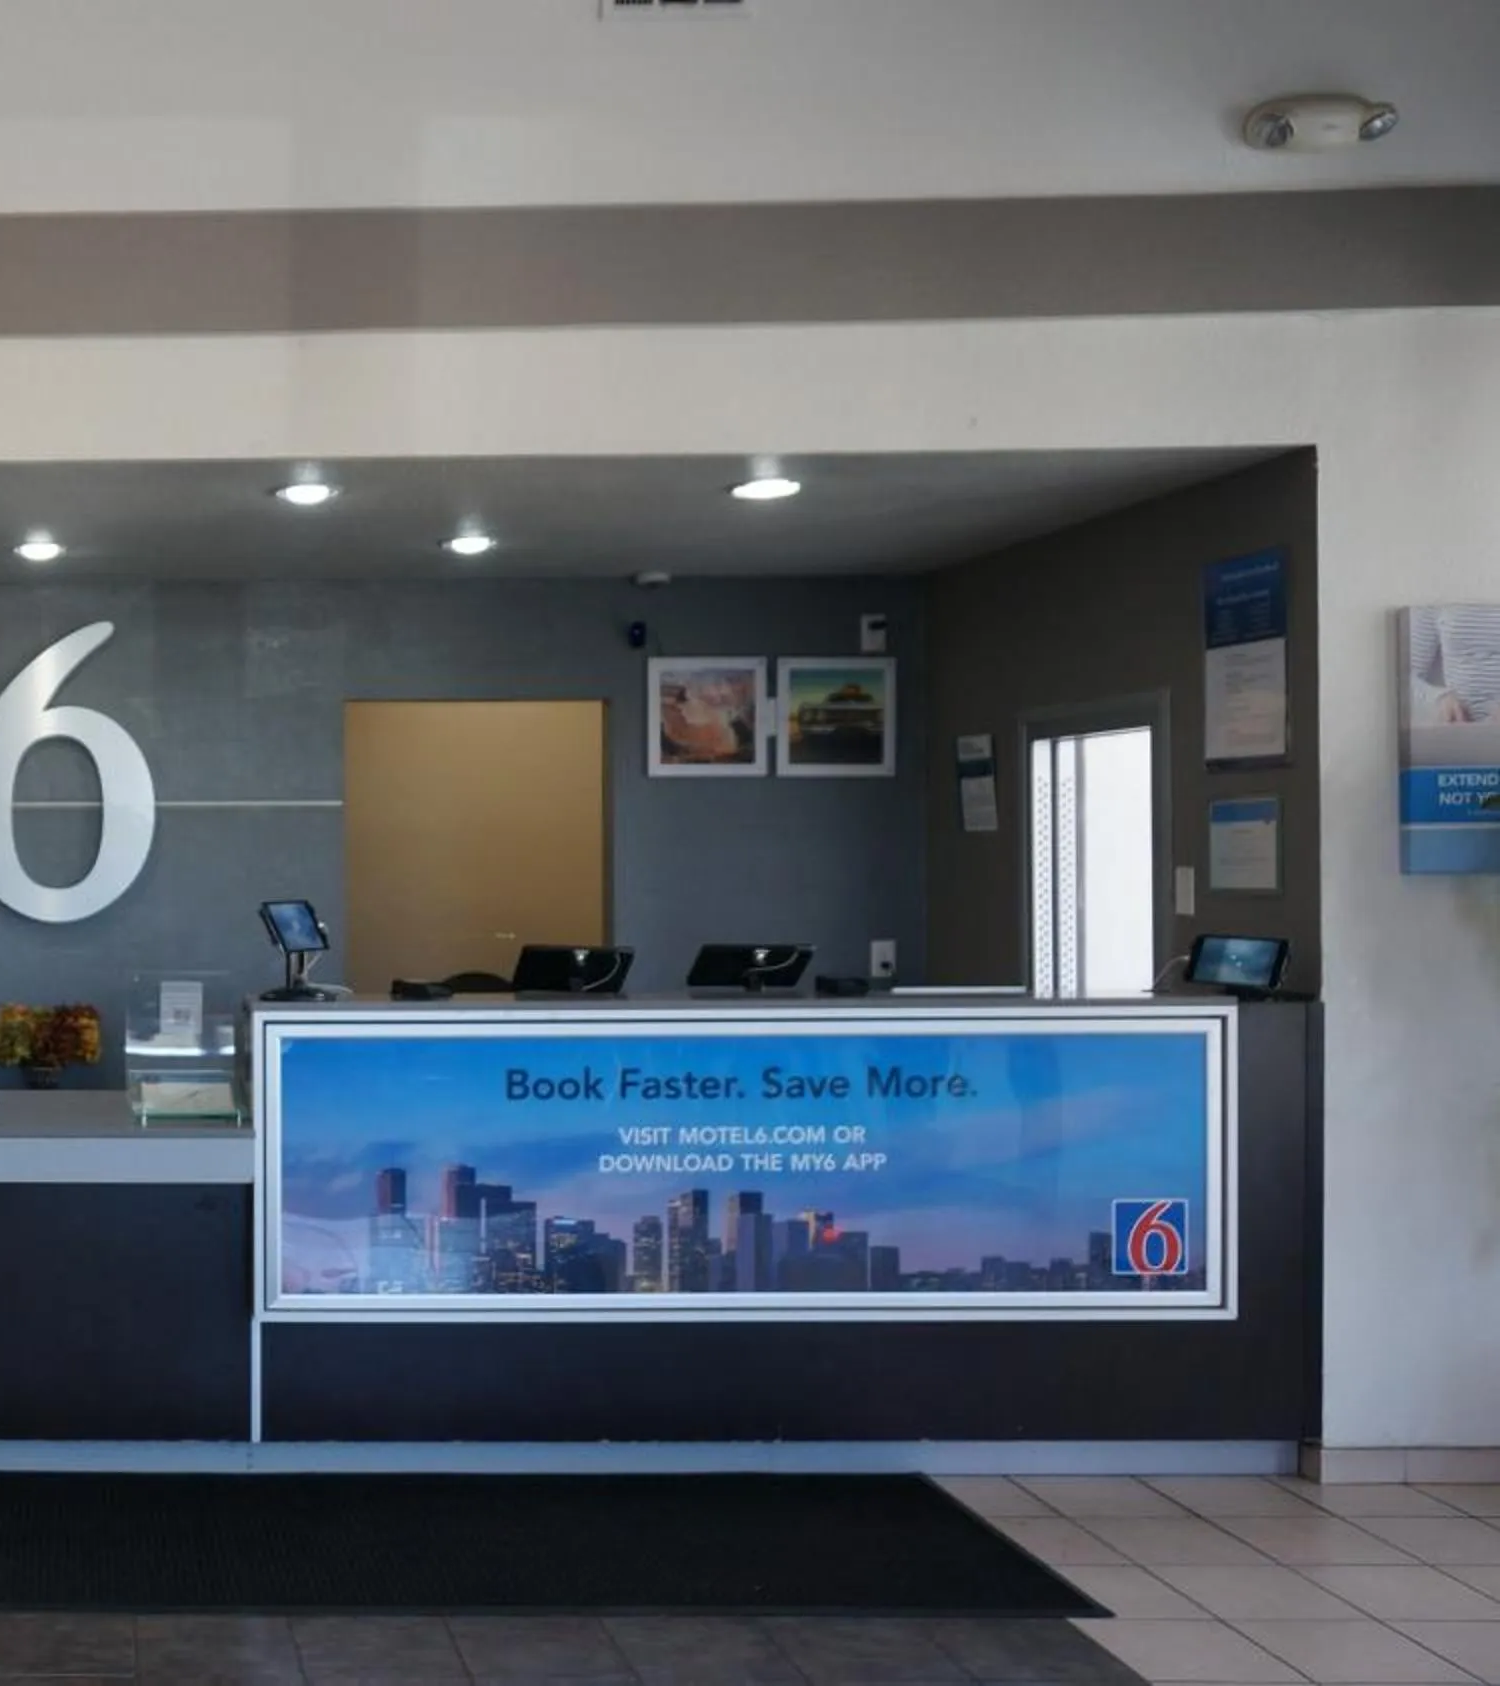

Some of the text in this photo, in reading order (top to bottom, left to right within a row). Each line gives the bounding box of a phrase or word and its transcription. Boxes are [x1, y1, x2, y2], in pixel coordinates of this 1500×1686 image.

[1438, 773, 1499, 787] EXTEND
[1440, 792, 1471, 805] NOT
[506, 1067, 978, 1100] Book Faster. Save More.
[618, 1125, 866, 1145] VISIT MOTEL6.COM OR
[599, 1152, 887, 1172] DOWNLOAD THE MY6 APP
[1128, 1200, 1182, 1274] 6
